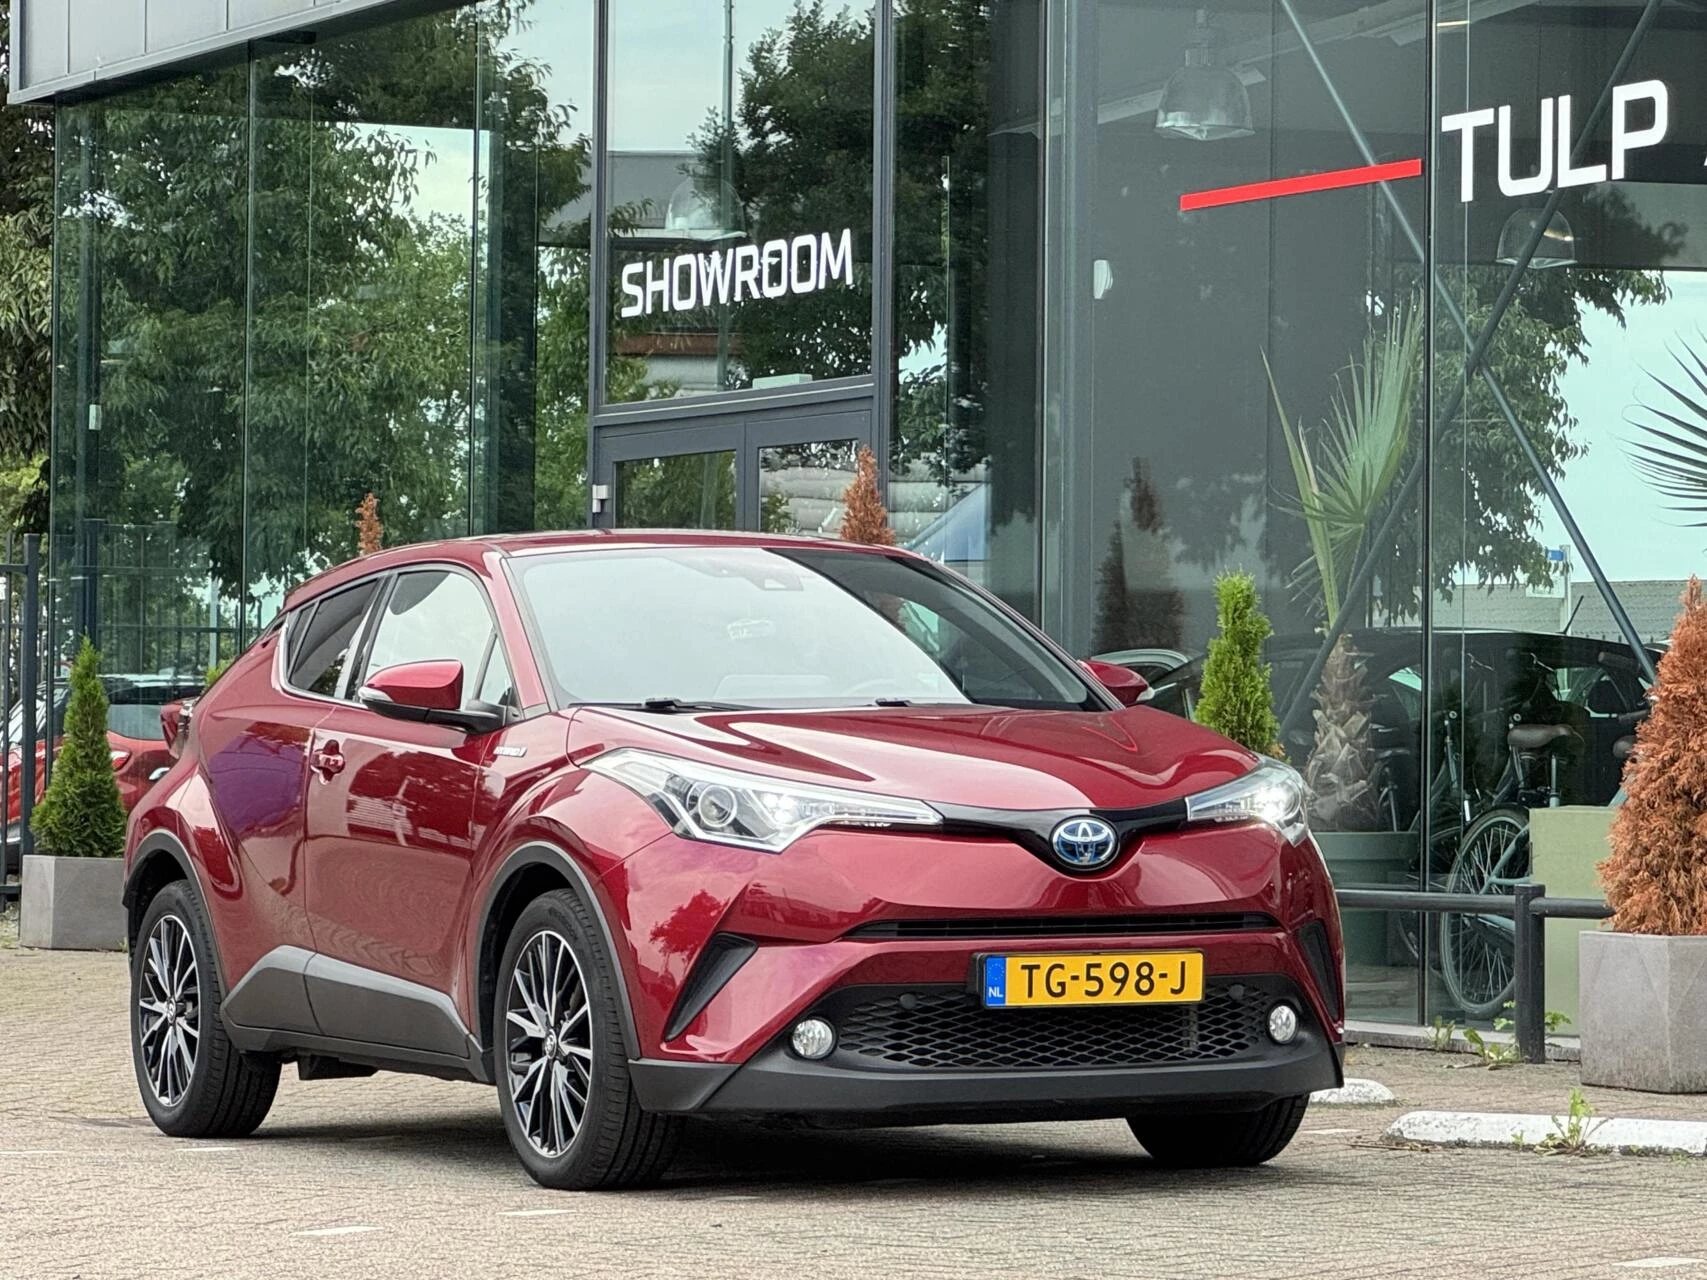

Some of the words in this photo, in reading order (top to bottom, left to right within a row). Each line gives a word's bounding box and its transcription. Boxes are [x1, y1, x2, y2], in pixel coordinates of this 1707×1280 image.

[1441, 79, 1668, 203] TULP
[621, 228, 853, 318] SHOWROOM
[988, 986, 1003, 999] NL
[1020, 960, 1187, 999] TG-598-J
